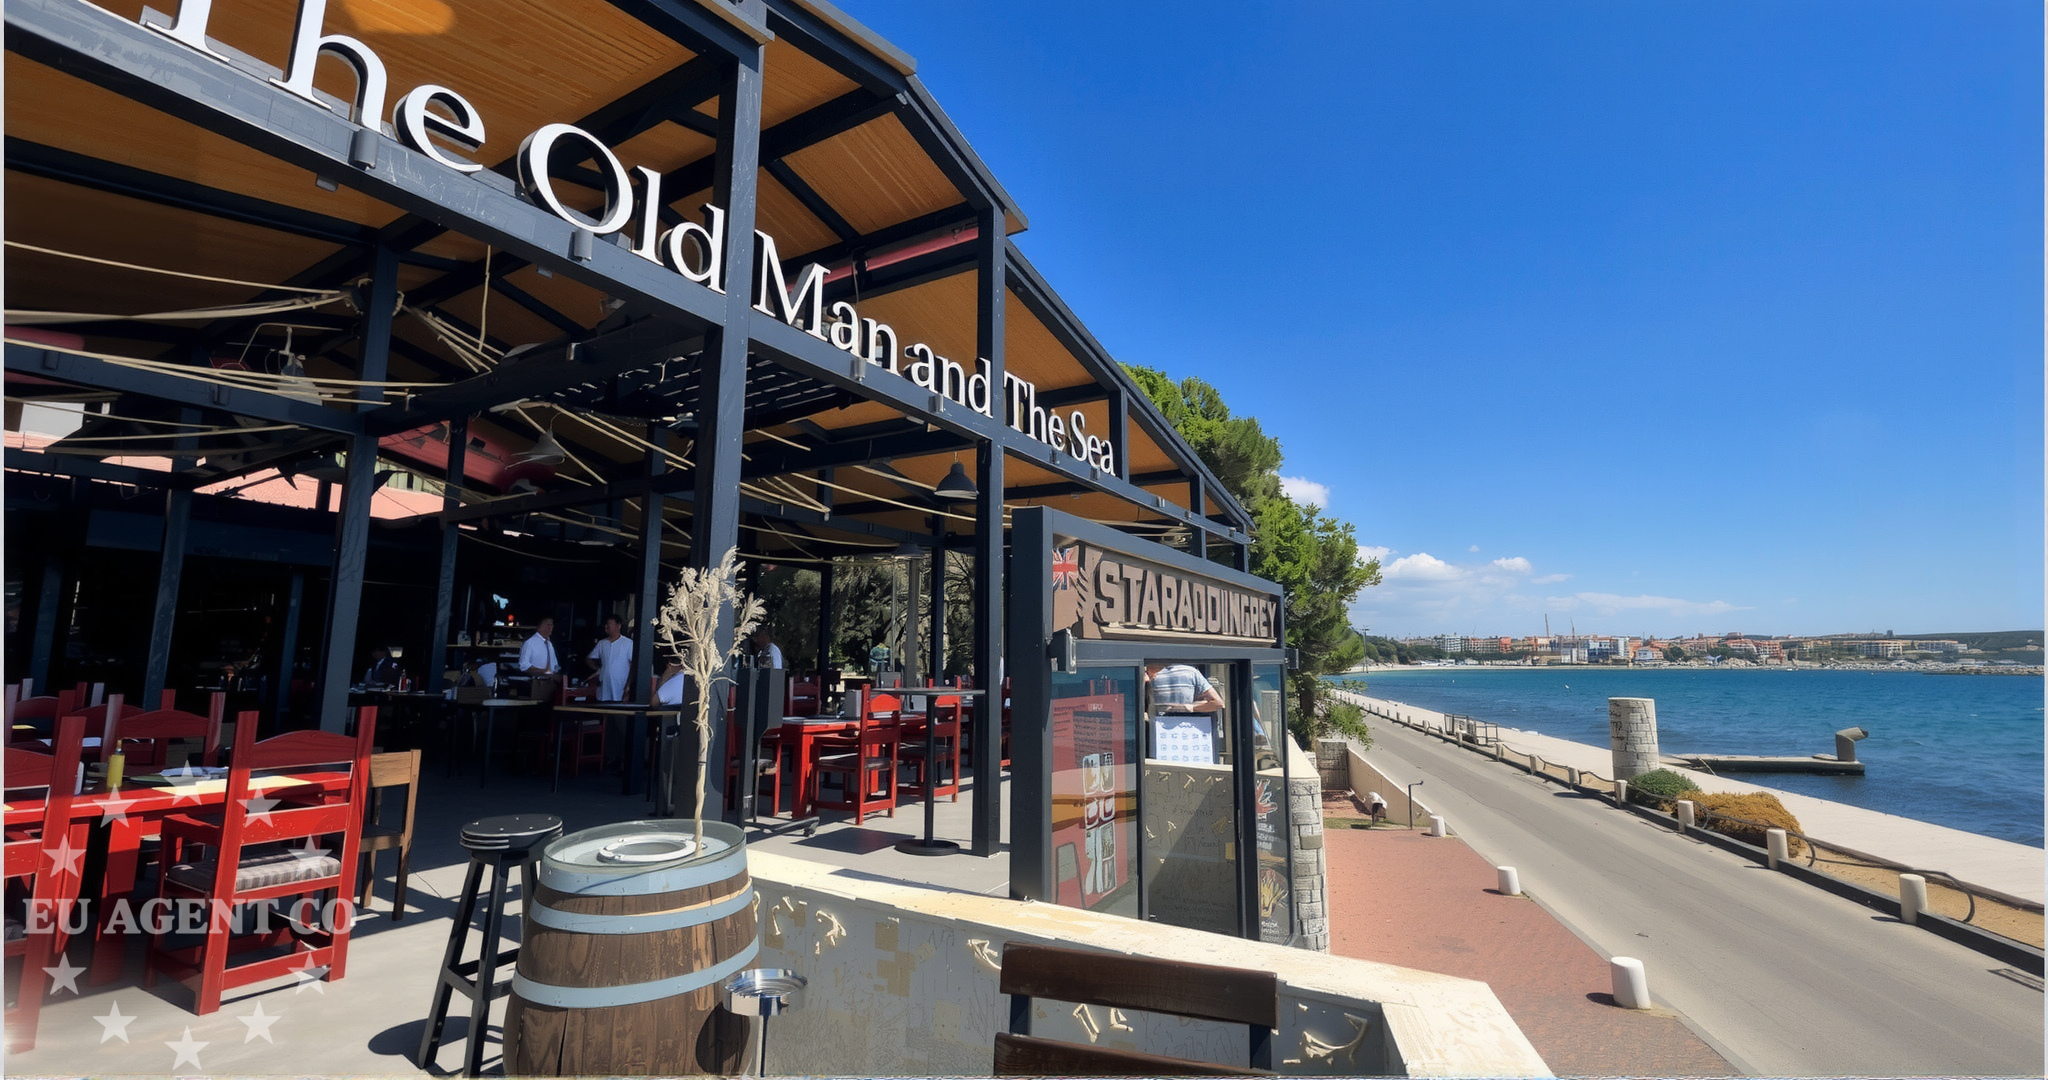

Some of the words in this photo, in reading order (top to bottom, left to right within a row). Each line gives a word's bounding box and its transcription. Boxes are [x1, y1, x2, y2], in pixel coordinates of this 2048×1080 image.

[146, 0, 485, 172] he
[519, 123, 726, 294] Old
[752, 229, 901, 376] Man
[905, 343, 993, 419] and
[1003, 370, 1065, 451] The
[1070, 411, 1115, 476] Sea
